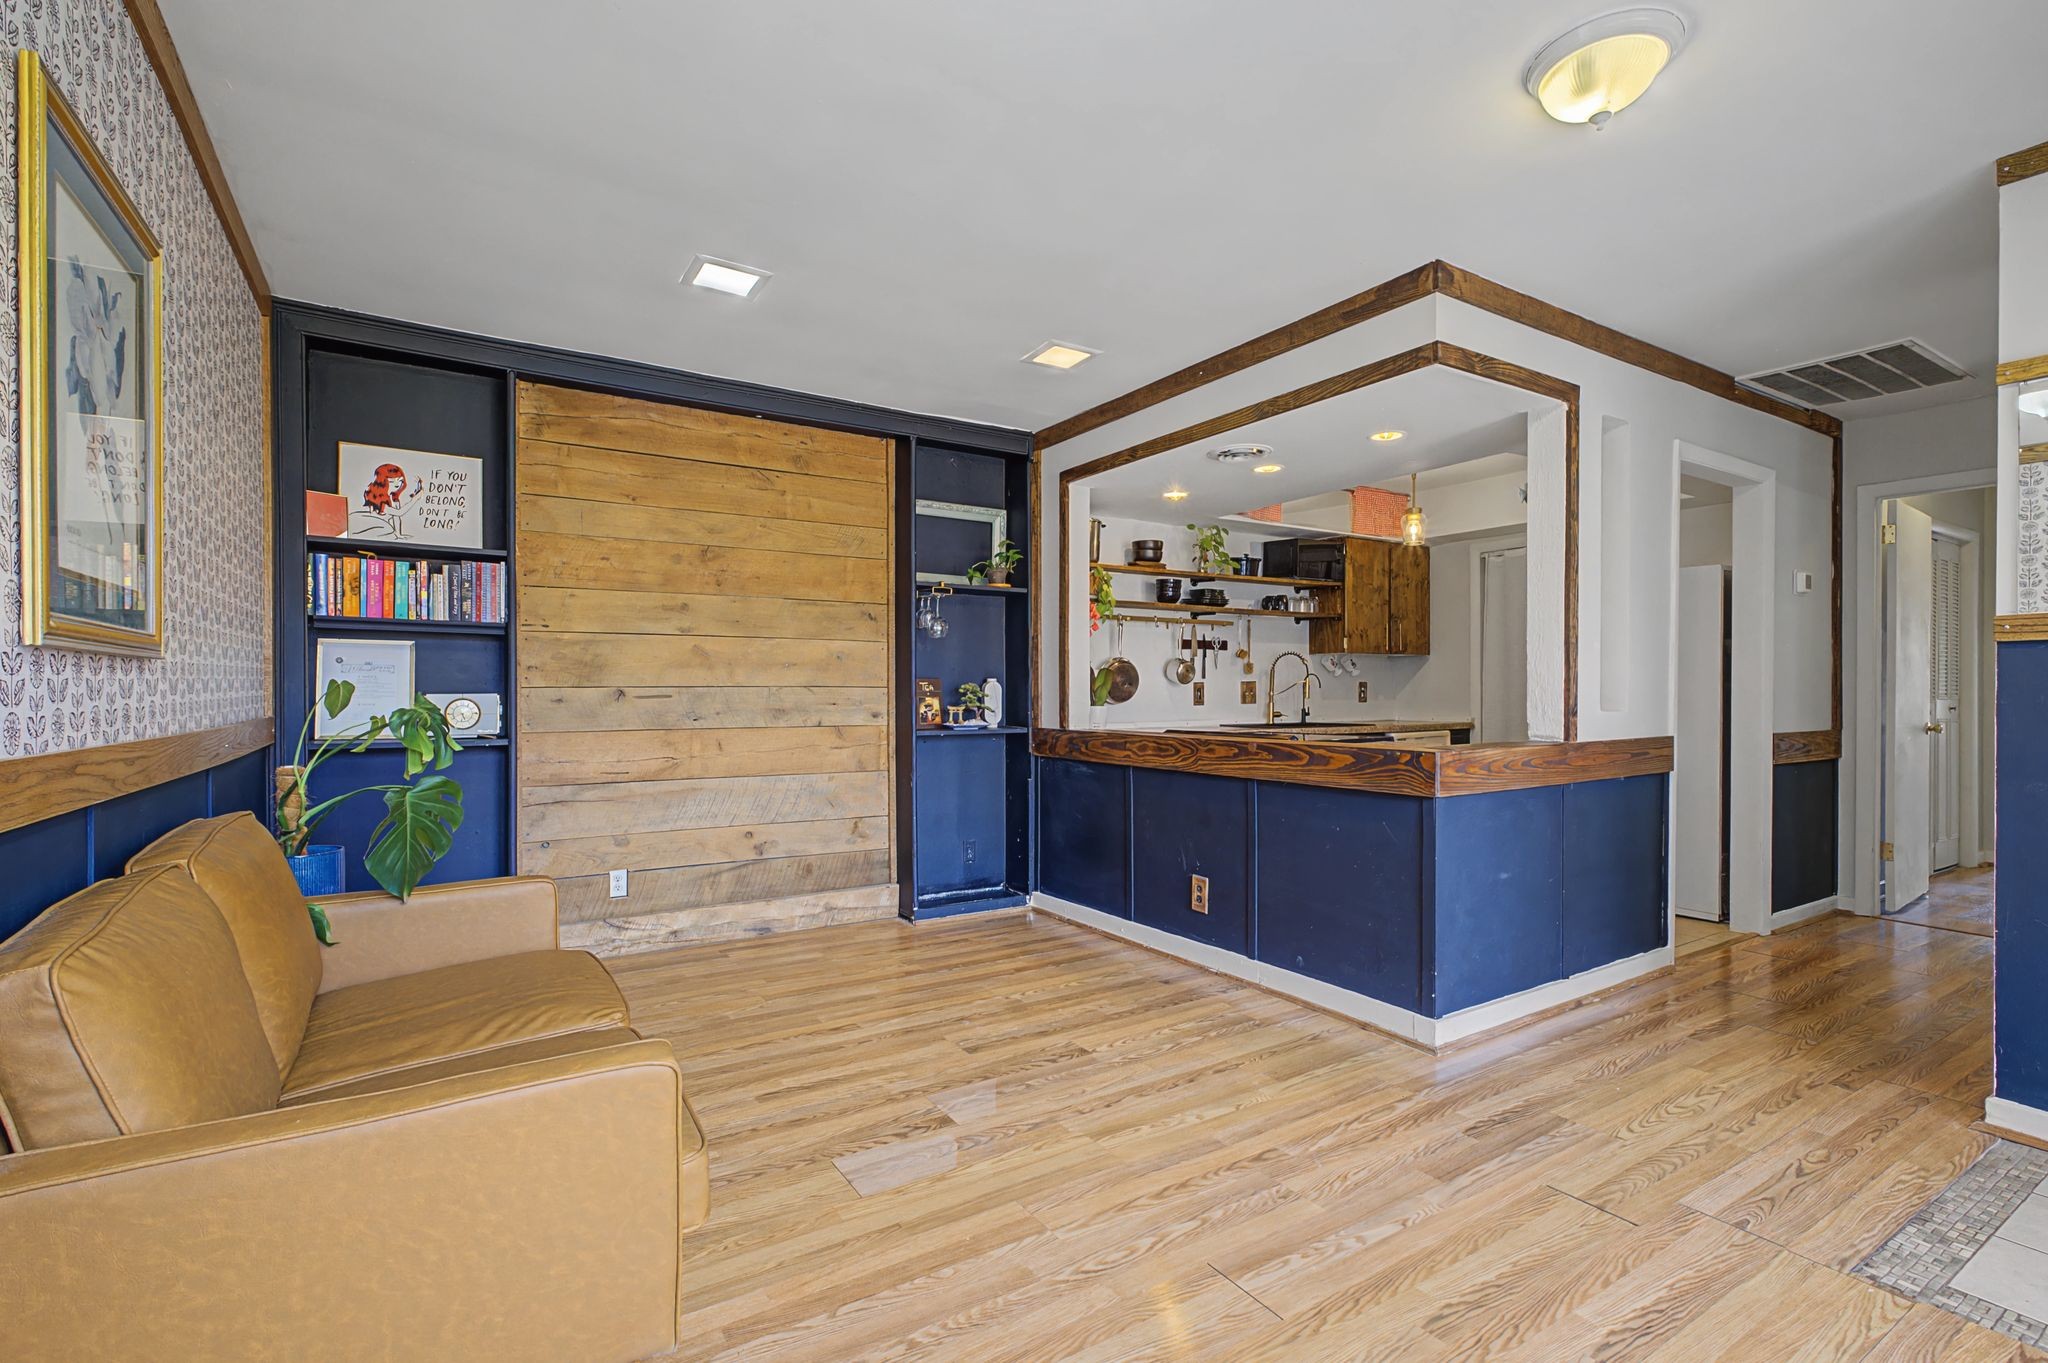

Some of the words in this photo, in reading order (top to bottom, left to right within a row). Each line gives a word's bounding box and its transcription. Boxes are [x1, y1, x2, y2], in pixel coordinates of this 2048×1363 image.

[431, 469, 442, 479] IF
[447, 471, 467, 481] YOU
[429, 481, 467, 494] DON'T
[425, 495, 466, 508] BELONG,
[457, 510, 467, 518] BE
[424, 517, 460, 531] LONG!
